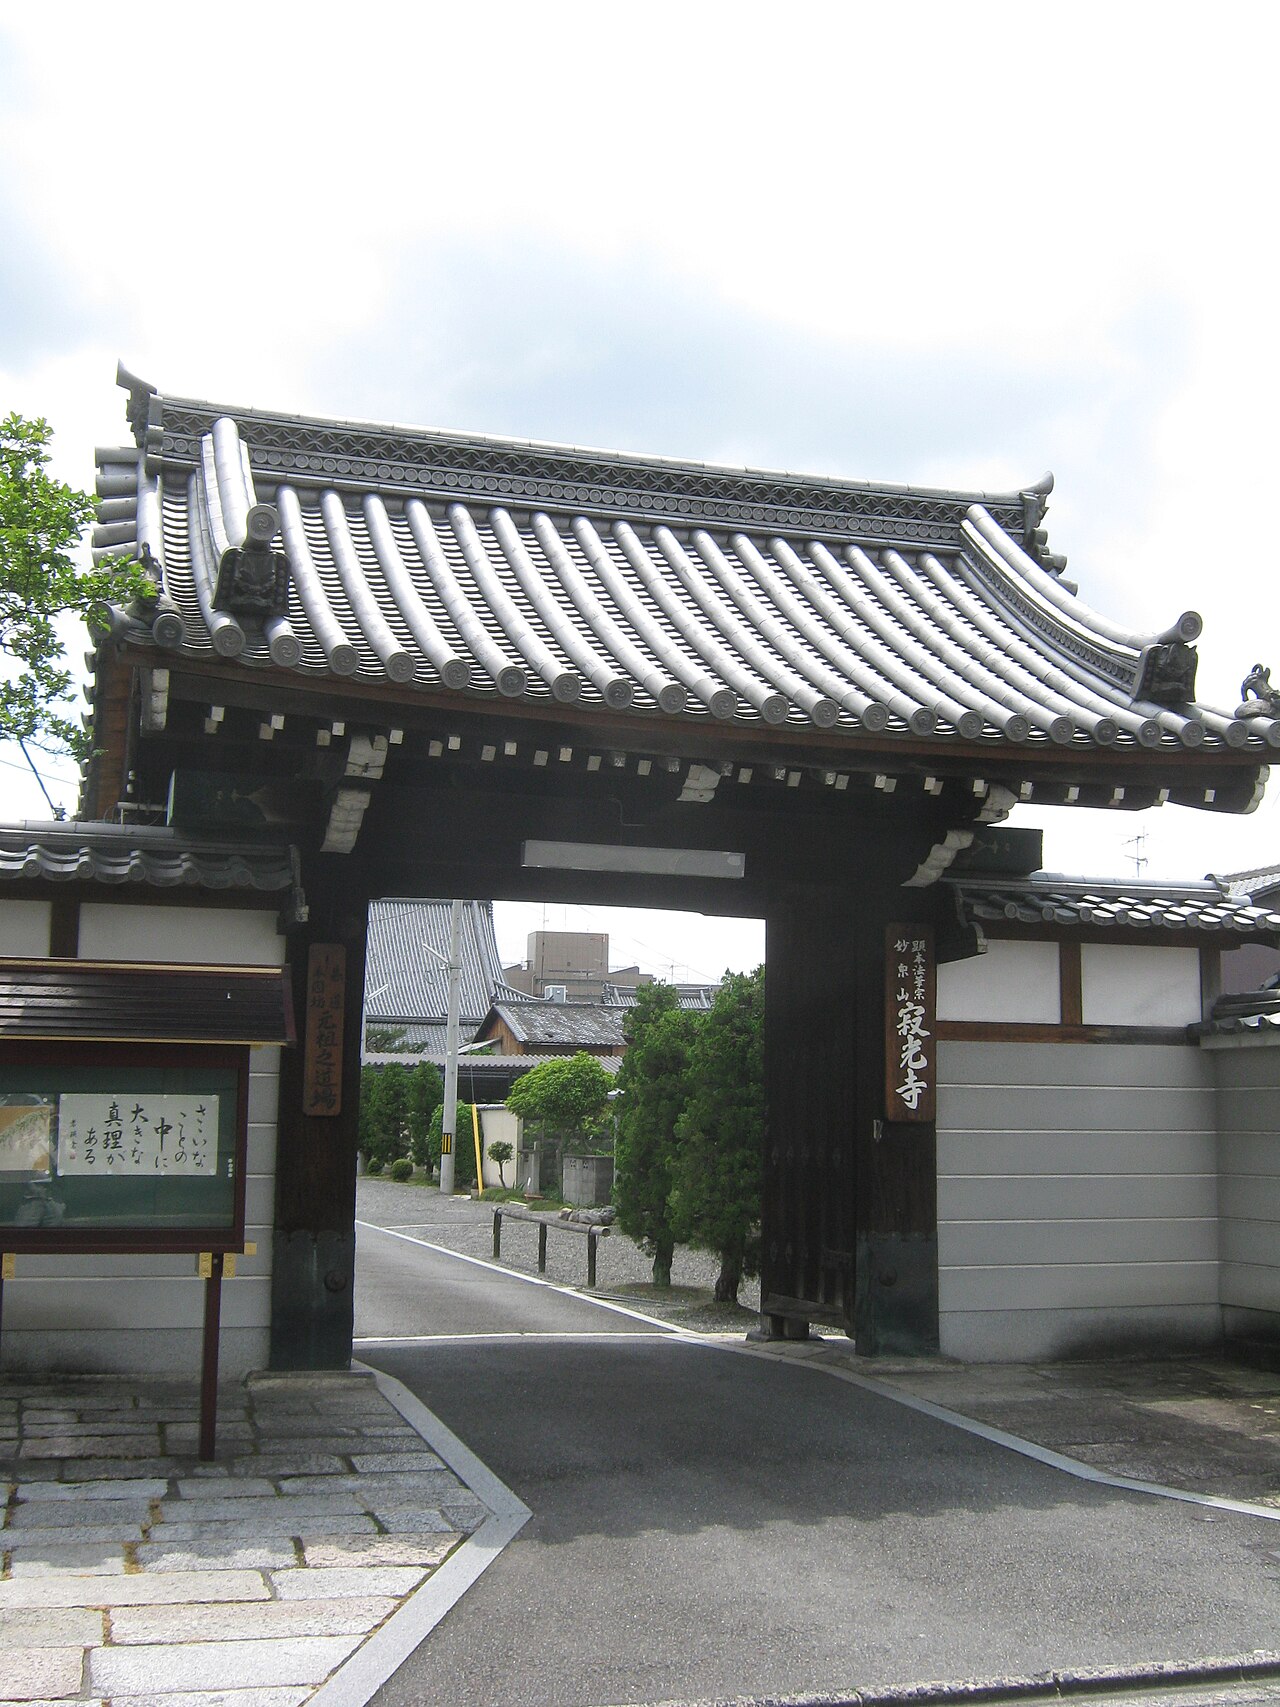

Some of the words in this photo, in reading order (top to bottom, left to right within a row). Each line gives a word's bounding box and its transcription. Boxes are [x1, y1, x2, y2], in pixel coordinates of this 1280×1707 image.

[894, 940, 909, 1001] 妙泉山
[895, 1001, 931, 1110] 寂光寺
[84, 1127, 98, 1166] ある
[102, 1101, 126, 1166] 真理が
[130, 1102, 149, 1165] 大きな
[153, 1116, 173, 1169] 中に
